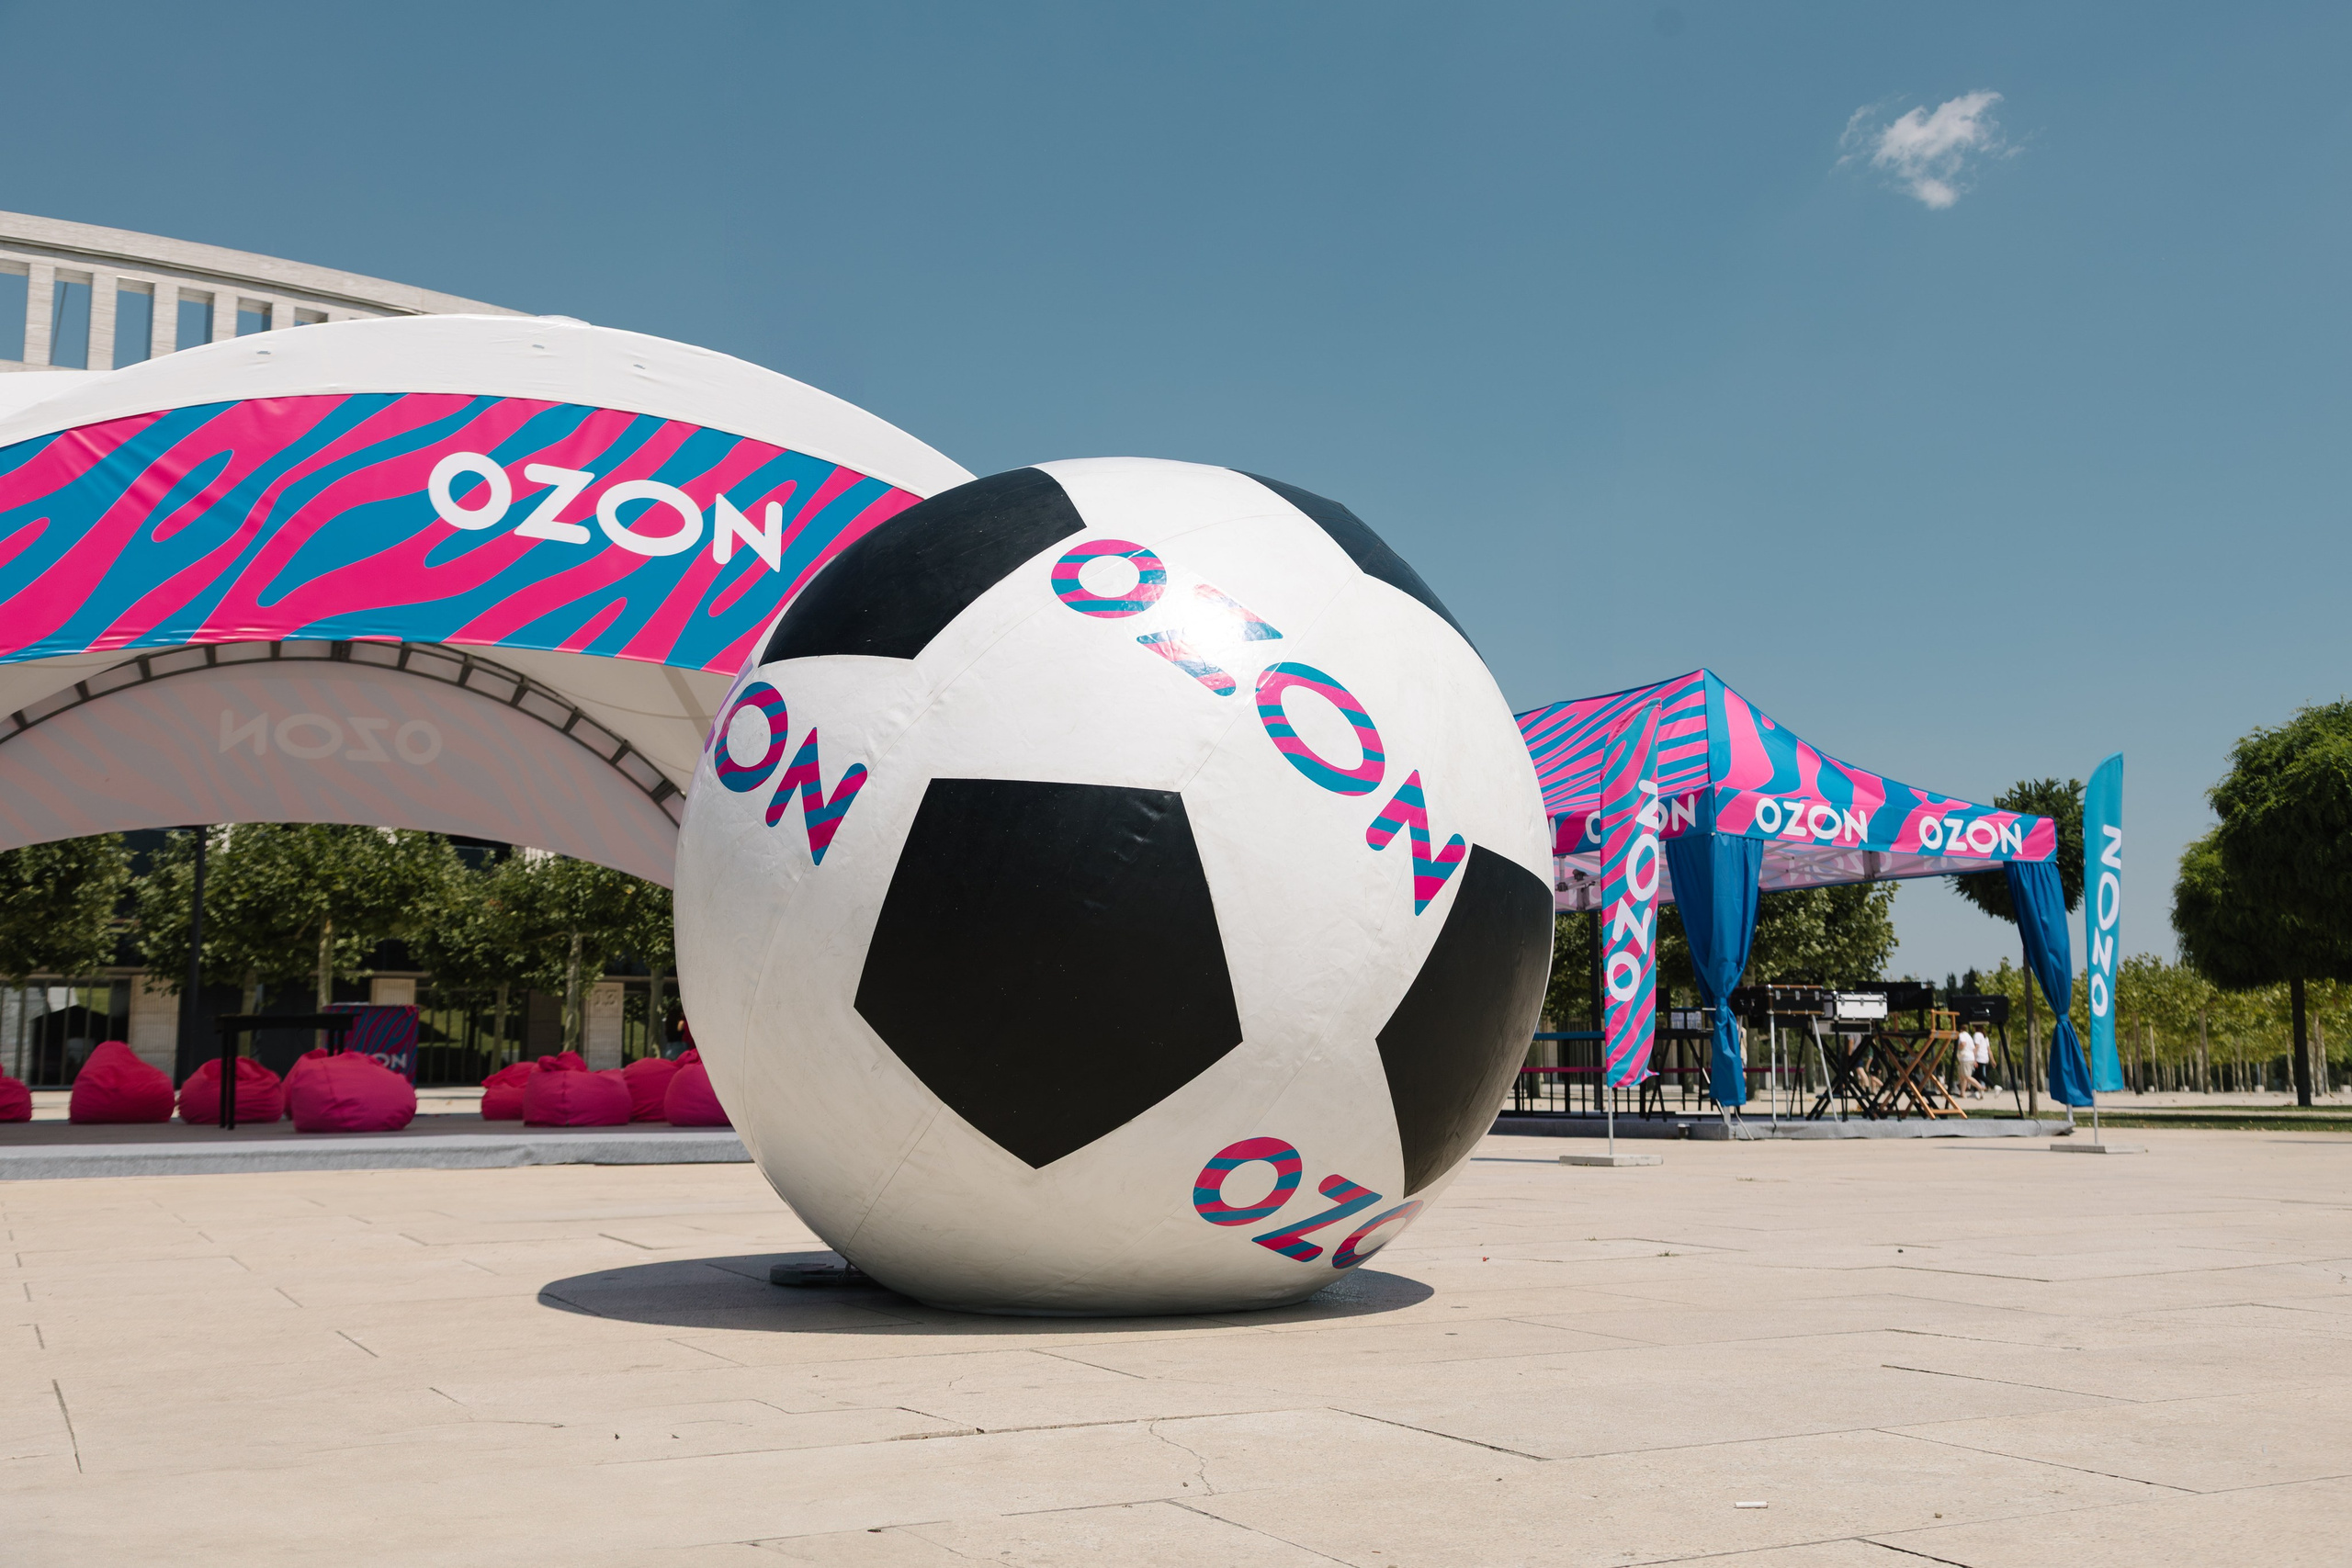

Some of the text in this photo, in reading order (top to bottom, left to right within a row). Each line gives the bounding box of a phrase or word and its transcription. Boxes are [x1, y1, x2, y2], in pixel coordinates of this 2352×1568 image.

[428, 451, 783, 572] OZON
[707, 665, 867, 866] ON
[1051, 539, 1465, 916] OZON
[1608, 780, 1659, 1002] OZON
[1755, 797, 1868, 843] OZON
[1919, 816, 2023, 855] OZON
[2091, 824, 2121, 1017] OZON
[366, 1052, 407, 1069] ON
